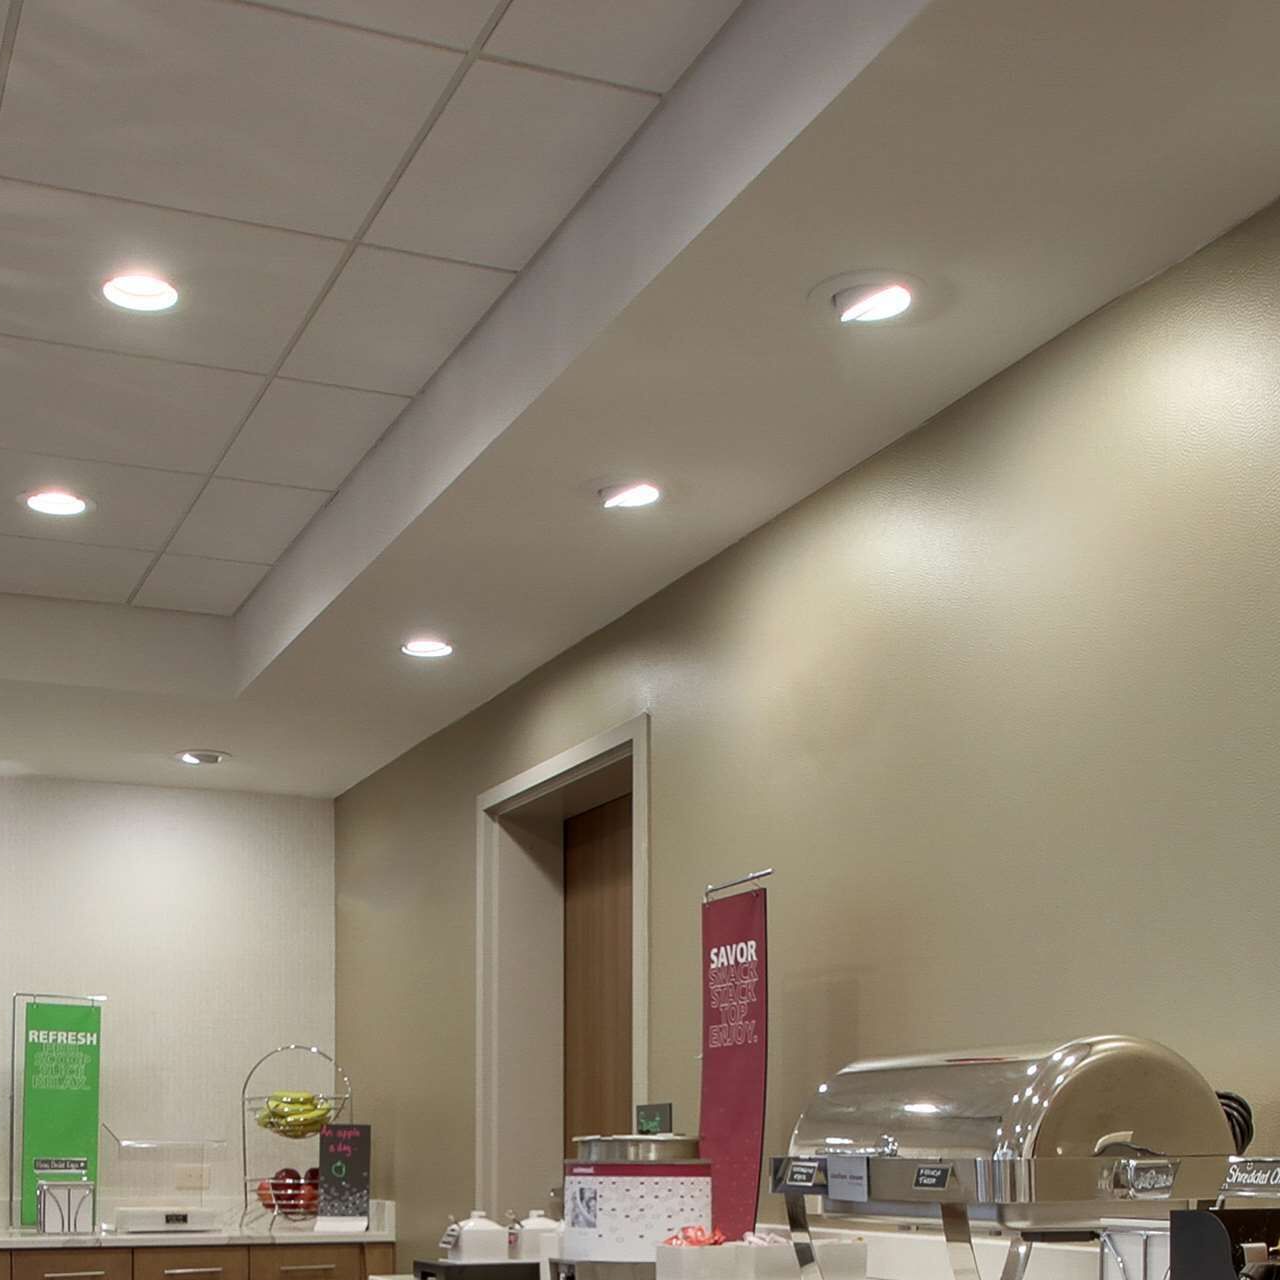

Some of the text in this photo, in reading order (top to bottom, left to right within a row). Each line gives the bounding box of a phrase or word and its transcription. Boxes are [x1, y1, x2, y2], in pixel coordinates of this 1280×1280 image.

[710, 940, 758, 969] SAVOR
[710, 979, 757, 1008] STACK
[720, 1000, 749, 1026] TOP
[28, 1030, 97, 1045] REFRESH
[709, 1020, 758, 1048] ENJOY.
[1226, 1164, 1270, 1184] Shredded
